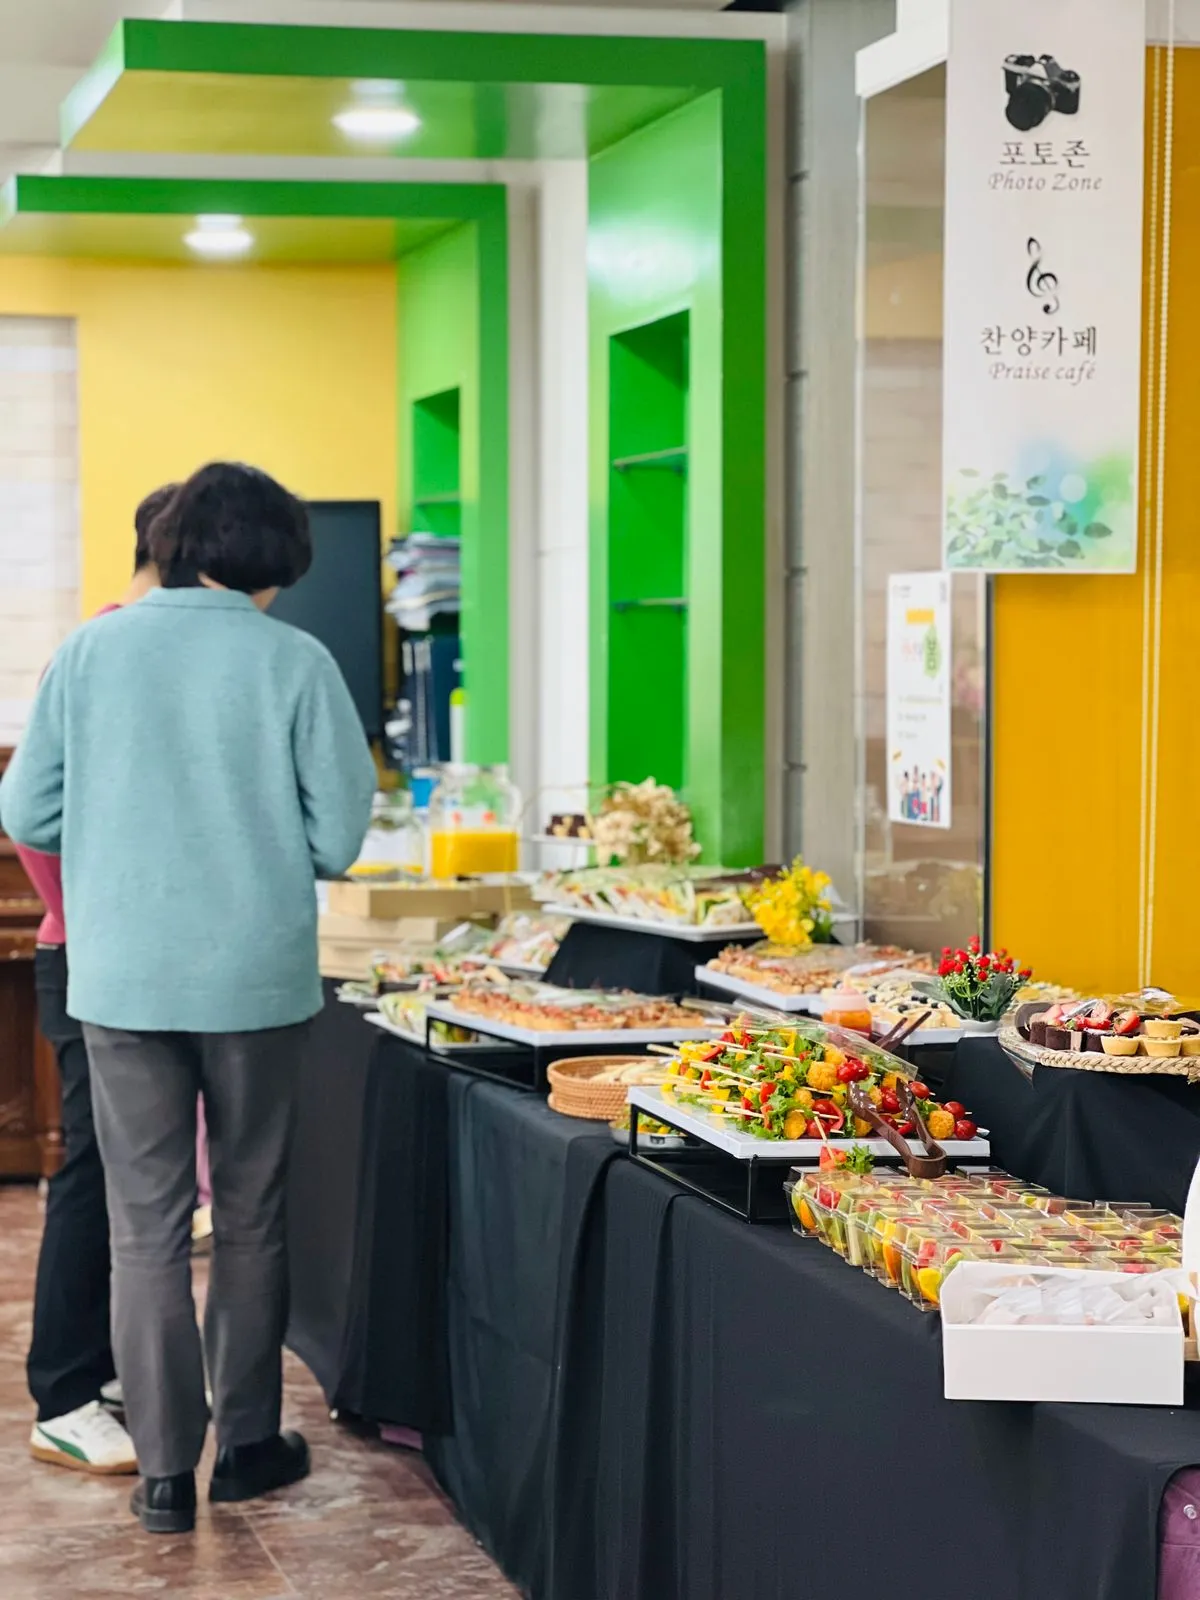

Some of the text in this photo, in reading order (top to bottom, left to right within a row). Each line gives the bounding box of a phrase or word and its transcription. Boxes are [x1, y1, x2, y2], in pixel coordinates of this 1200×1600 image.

[1000, 140, 1090, 168] 포토존
[988, 171, 1103, 191] Photo Zone
[980, 325, 1097, 357] 찬양카페
[990, 361, 1096, 386] Praise café
